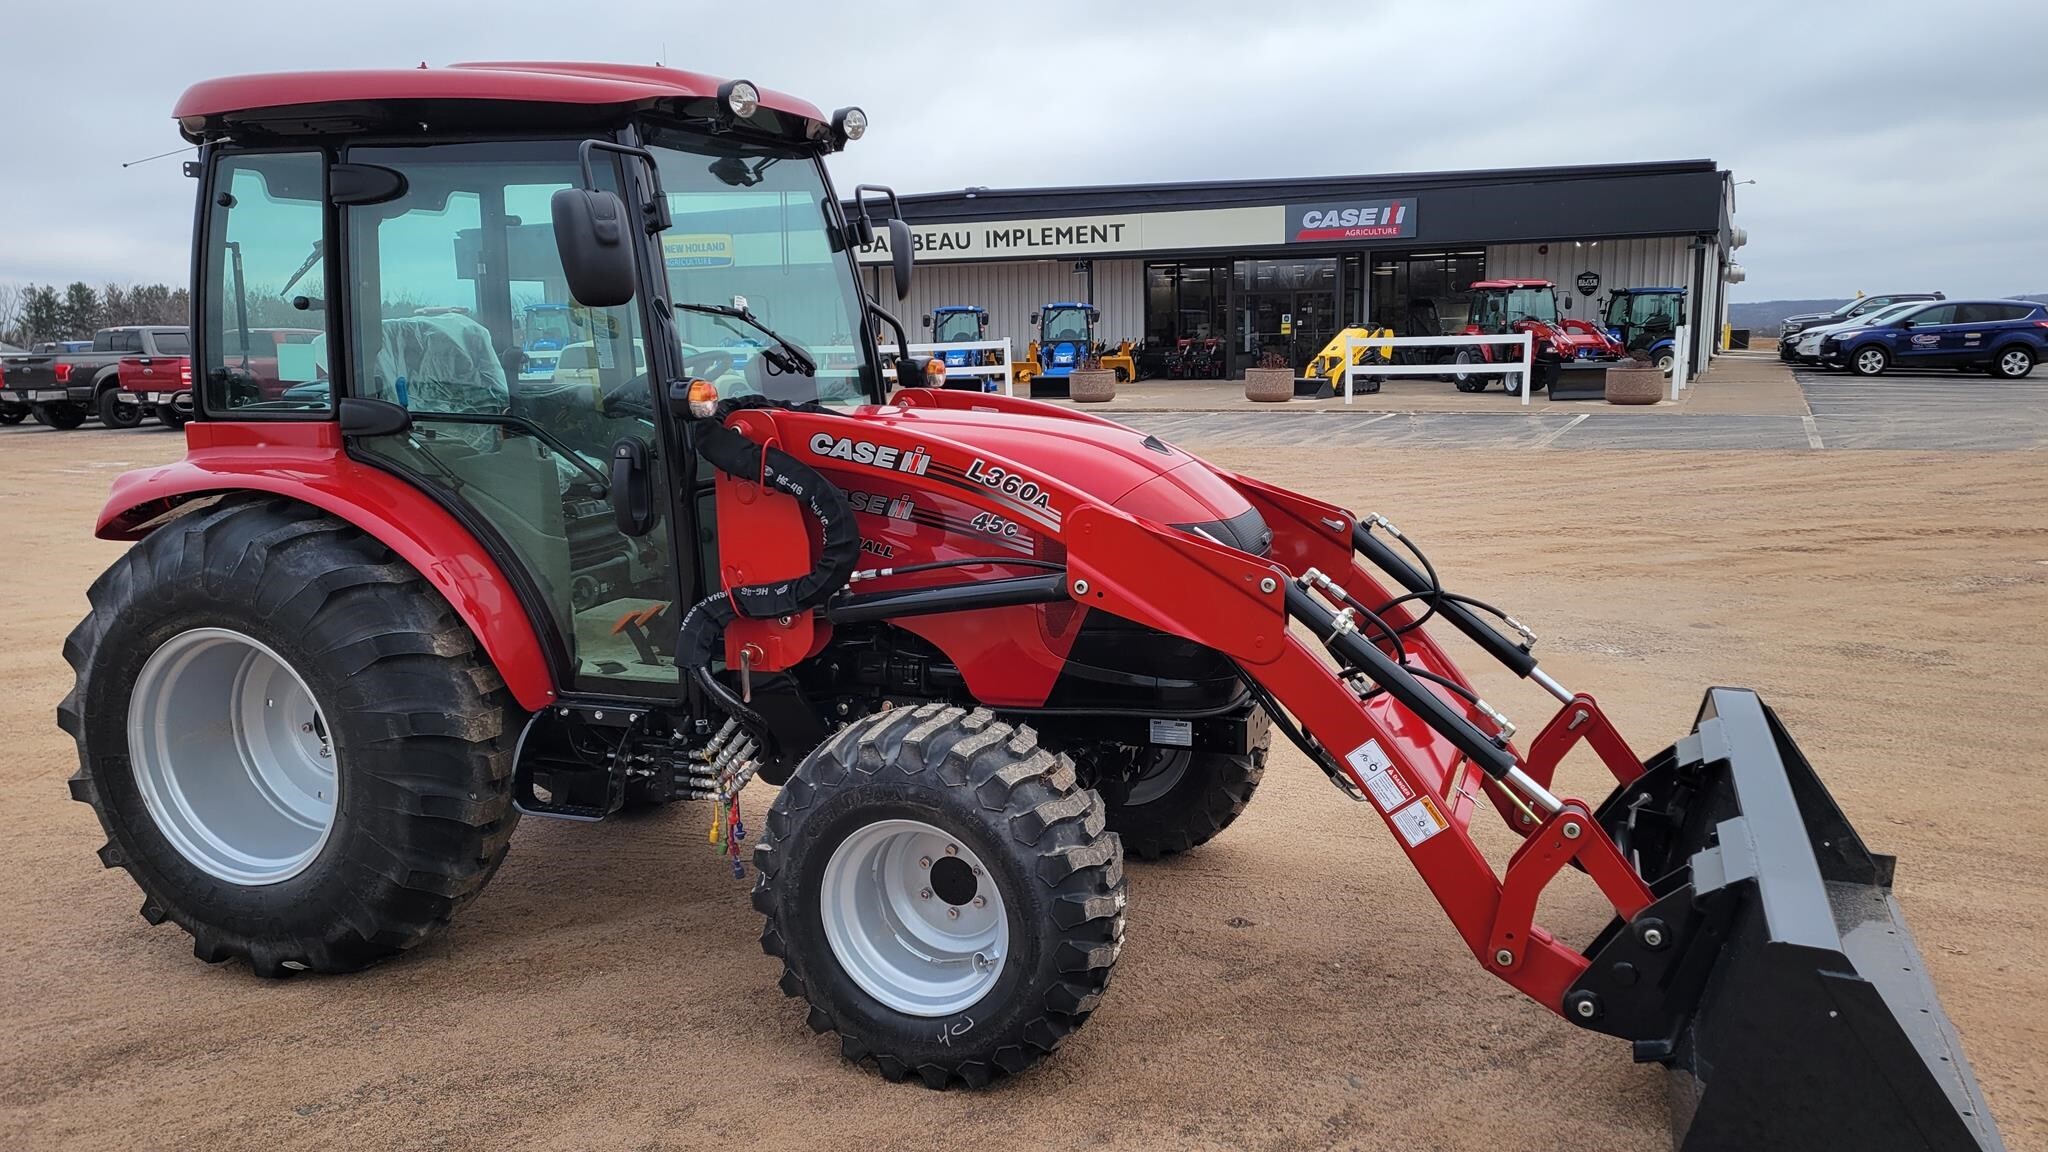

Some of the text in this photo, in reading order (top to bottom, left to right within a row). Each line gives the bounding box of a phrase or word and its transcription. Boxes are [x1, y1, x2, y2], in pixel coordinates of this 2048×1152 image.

[1302, 208, 1378, 228] CASE
[859, 223, 1126, 254] BABEAU IMPLEMENT
[1345, 227, 1397, 237] AGRICULTURE
[664, 241, 725, 254] NEW HOLLAND
[809, 432, 899, 469] CASE
[965, 458, 1050, 511] L360A
[1392, 775, 1411, 797] DANGER
